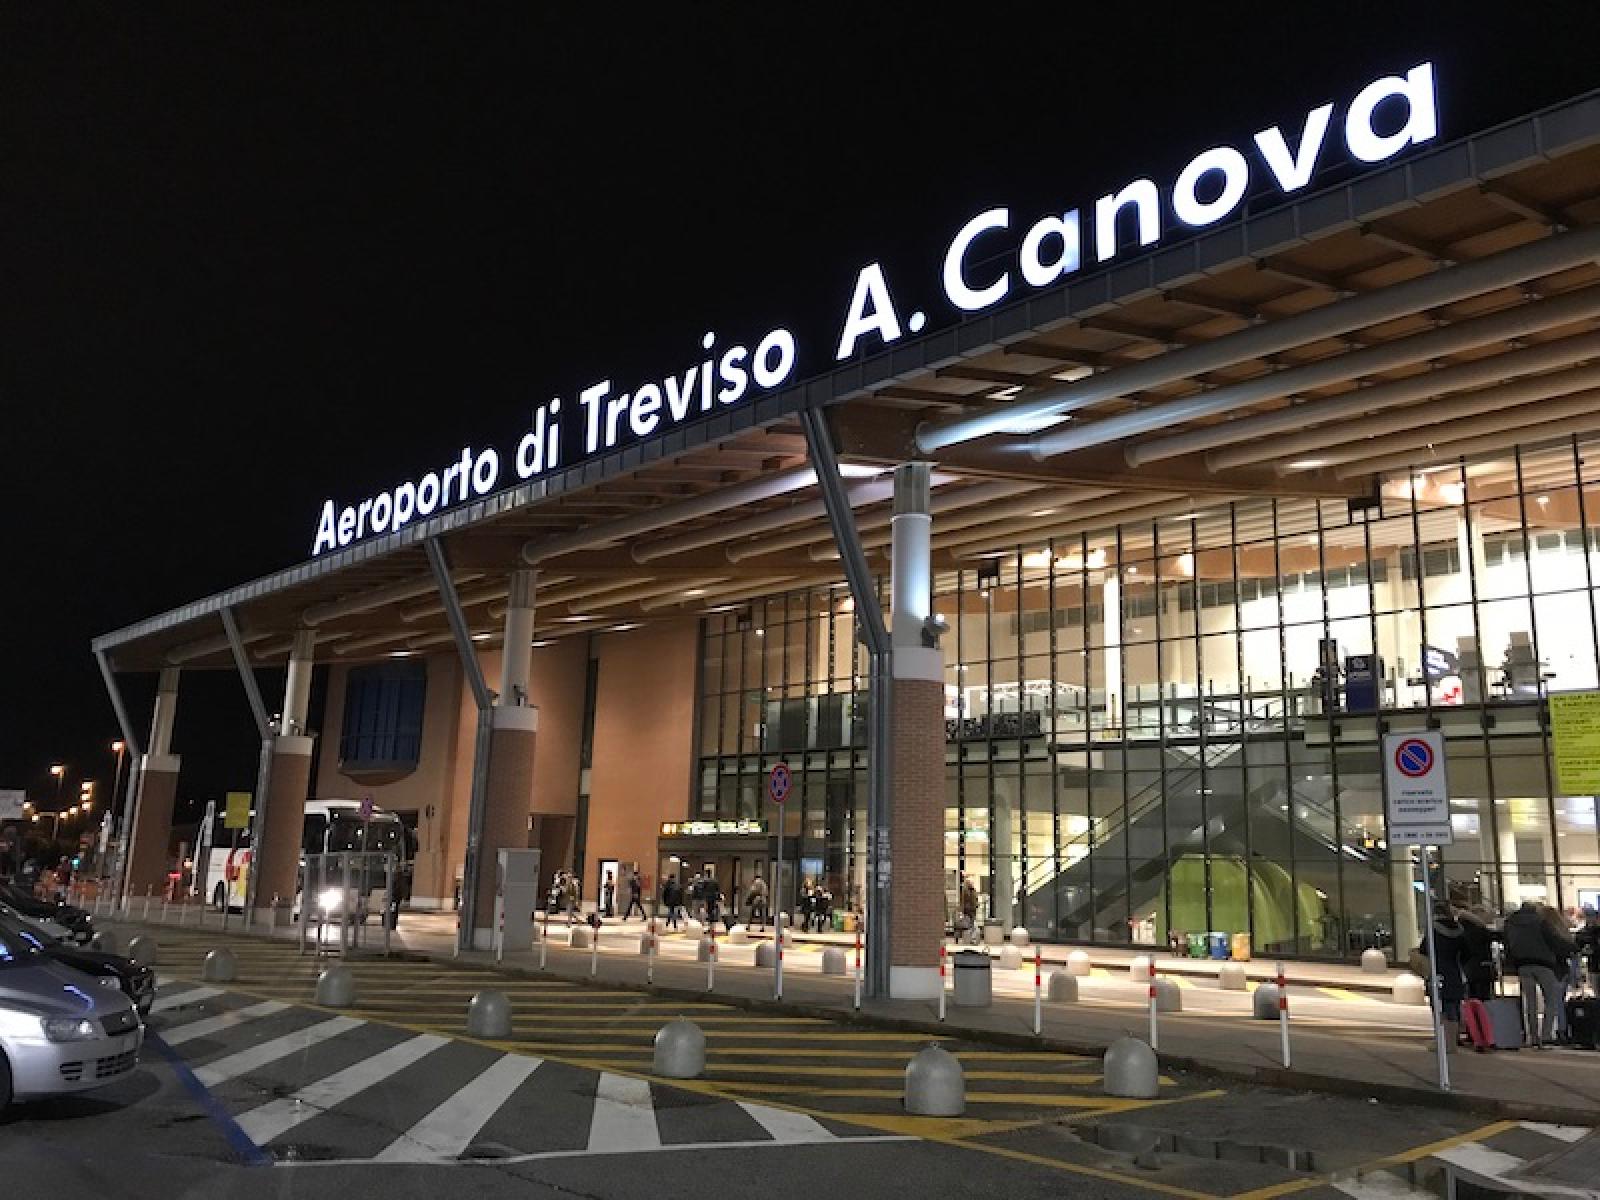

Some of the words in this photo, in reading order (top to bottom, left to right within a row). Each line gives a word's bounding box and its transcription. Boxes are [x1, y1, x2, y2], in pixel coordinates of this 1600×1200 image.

[311, 447, 499, 556] Aeroporto
[515, 397, 561, 479] di
[579, 329, 796, 454] Treviso
[836, 262, 926, 361] A.
[942, 61, 1438, 312] Canova
